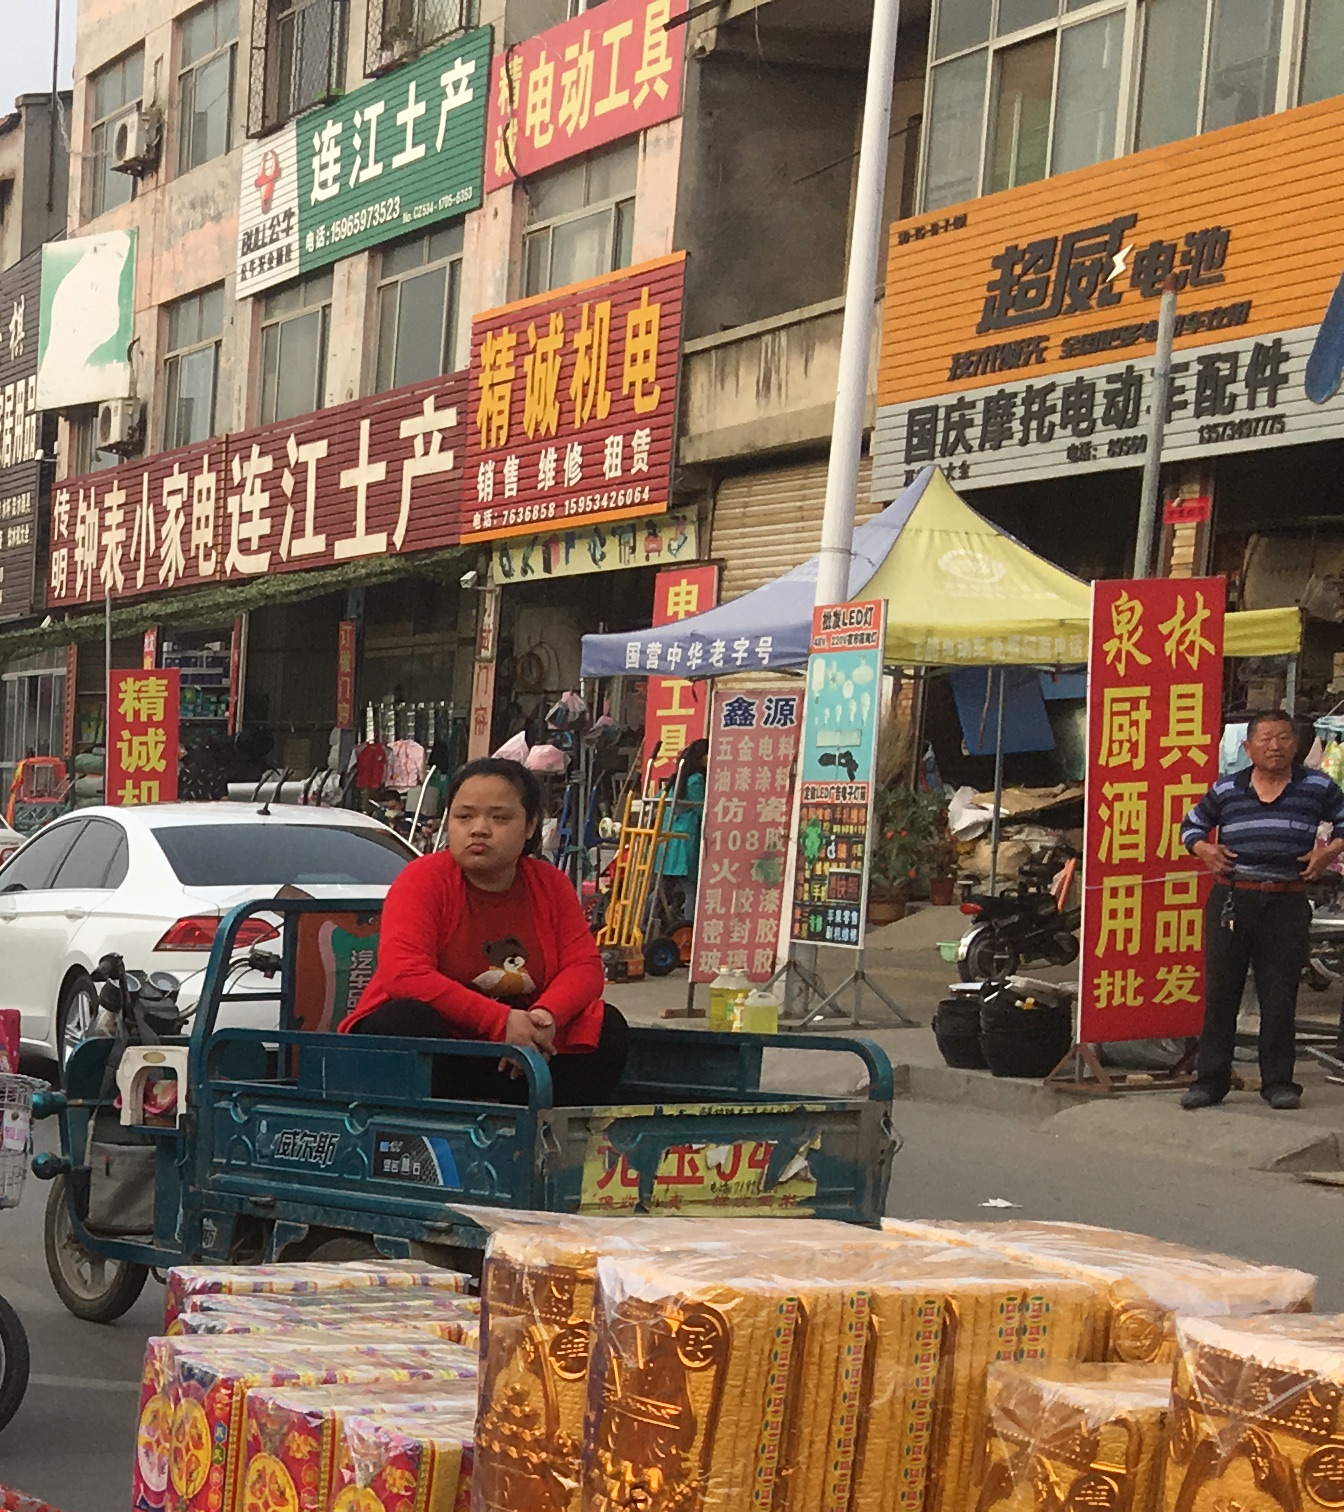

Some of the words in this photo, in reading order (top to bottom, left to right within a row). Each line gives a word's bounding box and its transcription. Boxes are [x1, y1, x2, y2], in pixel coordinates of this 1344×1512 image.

[525, 3, 673, 148] 电动工具
[311, 57, 476, 206] 连江土产
[476, 287, 661, 450] 精诚机电
[224, 394, 459, 576] 连江土产
[477, 454, 519, 502] 销售
[537, 442, 582, 491] 维修
[603, 427, 651, 480] 租赁
[74, 453, 218, 602] 钟表小家电
[625, 636, 774, 670] 国营中华老字号
[723, 696, 798, 729] 鑫源
[1097, 682, 1212, 771] 厨具
[711, 826, 788, 854] 108胶
[714, 796, 787, 823] 仿瓷
[702, 917, 777, 944] 密封胶
[705, 887, 782, 915] 乳胶漆
[1095, 870, 1203, 959] 用品
[1093, 965, 1202, 1010] 批发
